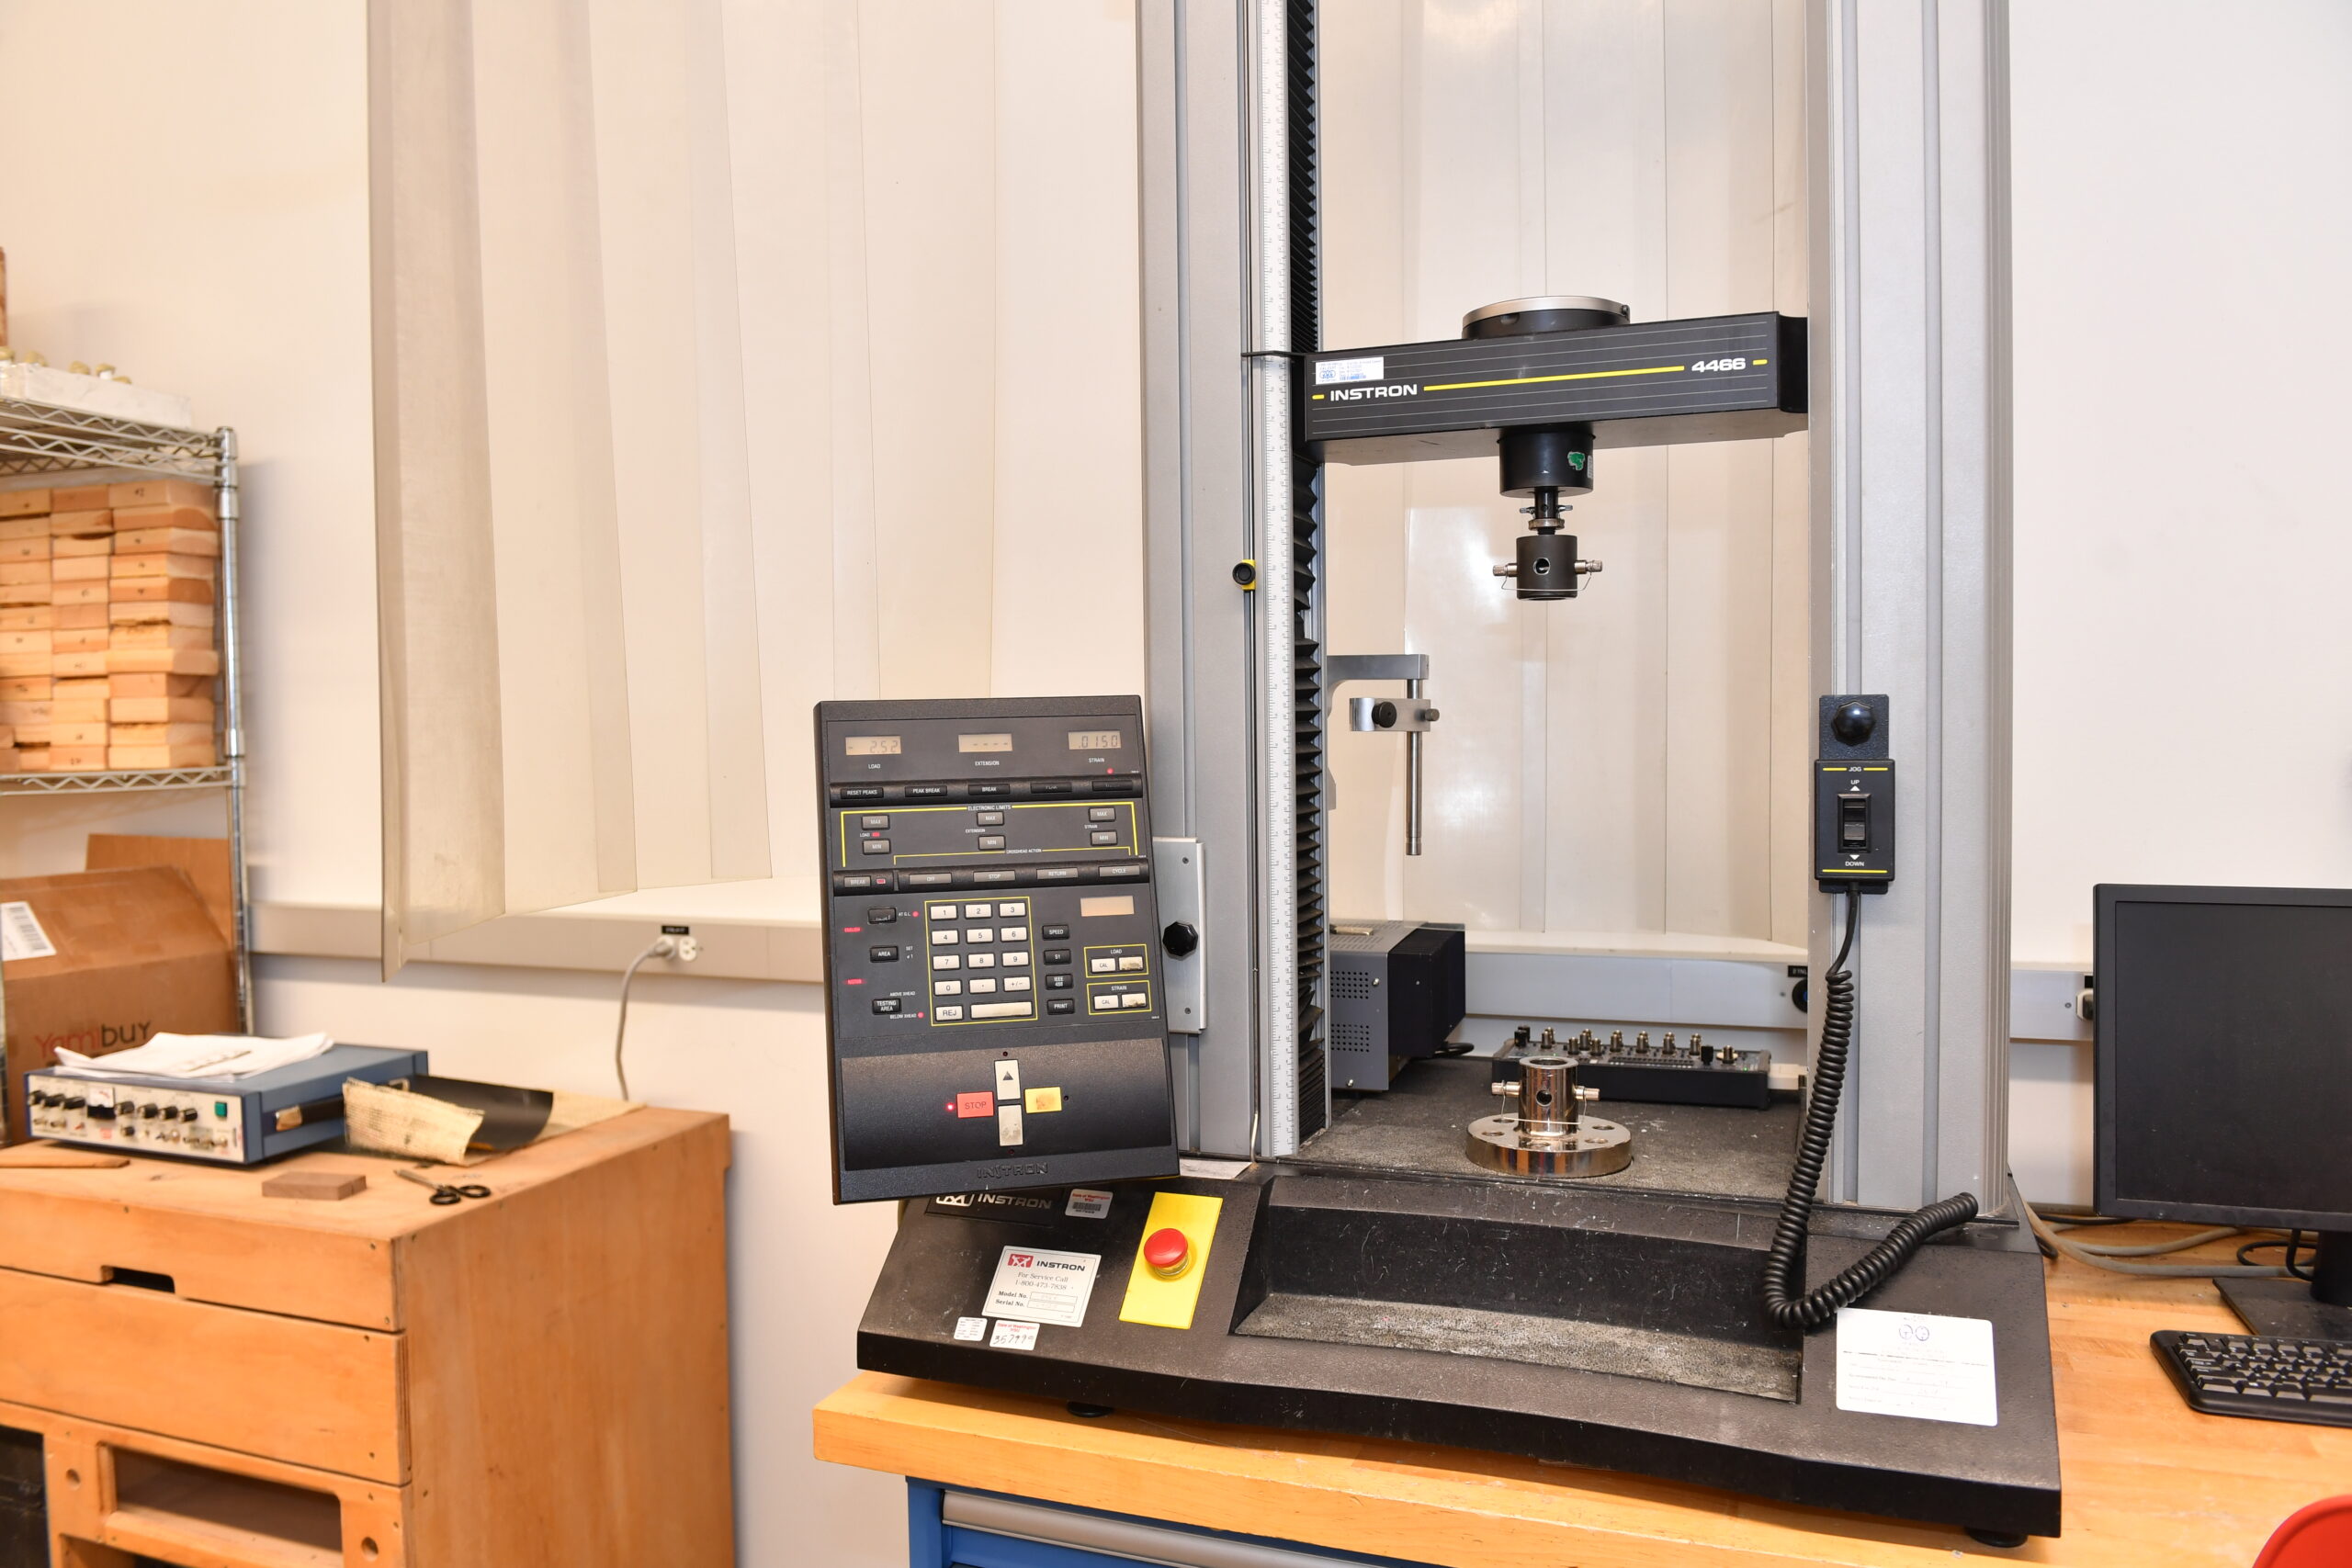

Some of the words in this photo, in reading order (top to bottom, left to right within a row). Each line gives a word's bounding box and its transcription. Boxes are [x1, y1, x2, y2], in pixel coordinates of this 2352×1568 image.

[1691, 357, 1747, 373] 4466
[1329, 383, 1418, 401] INSTRON
[965, 1101, 987, 1110] STOP
[977, 1161, 1049, 1179] INSTRON
[977, 1193, 1053, 1210] INSTRON
[1036, 1260, 1086, 1272] INSTRON
[1030, 1272, 1055, 1281] Service
[1055, 1275, 1069, 1283] Call
